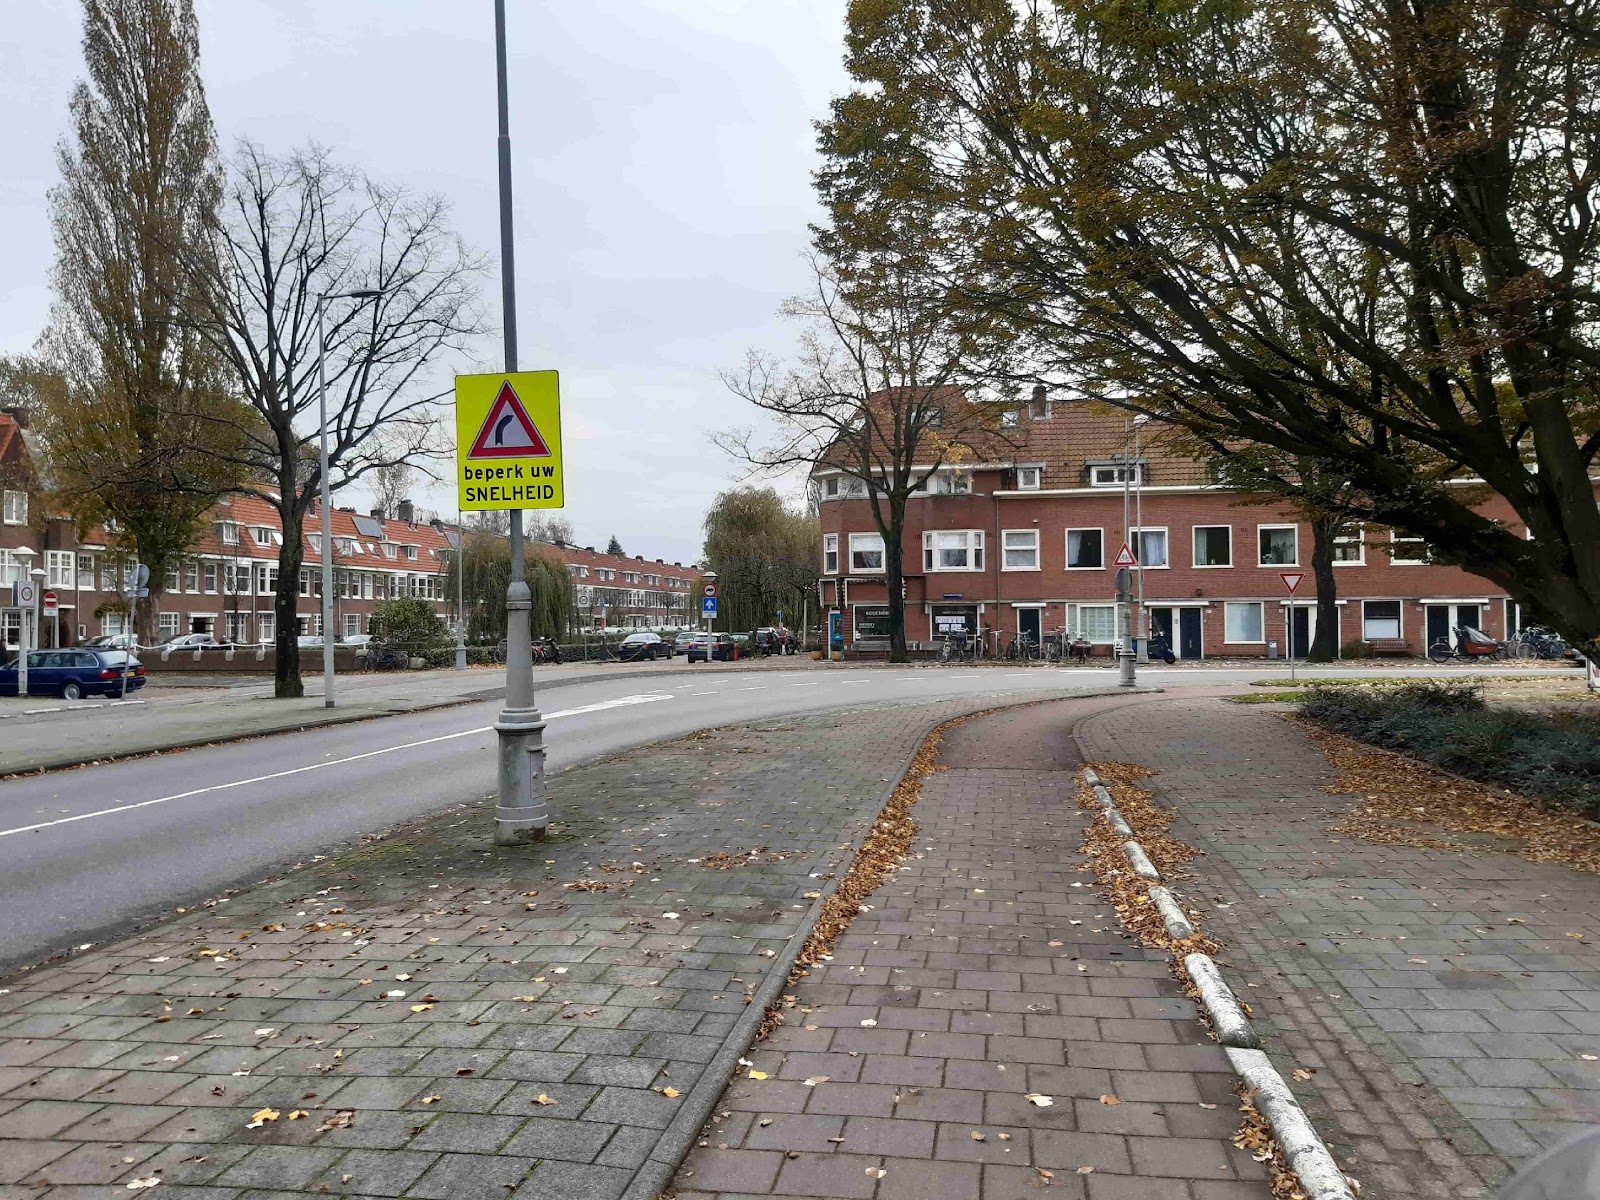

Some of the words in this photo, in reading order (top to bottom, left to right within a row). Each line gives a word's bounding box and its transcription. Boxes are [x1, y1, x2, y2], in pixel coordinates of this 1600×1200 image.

[464, 464, 523, 482] beperk
[531, 466, 554, 478] uw
[465, 485, 554, 502] SNELHEID
